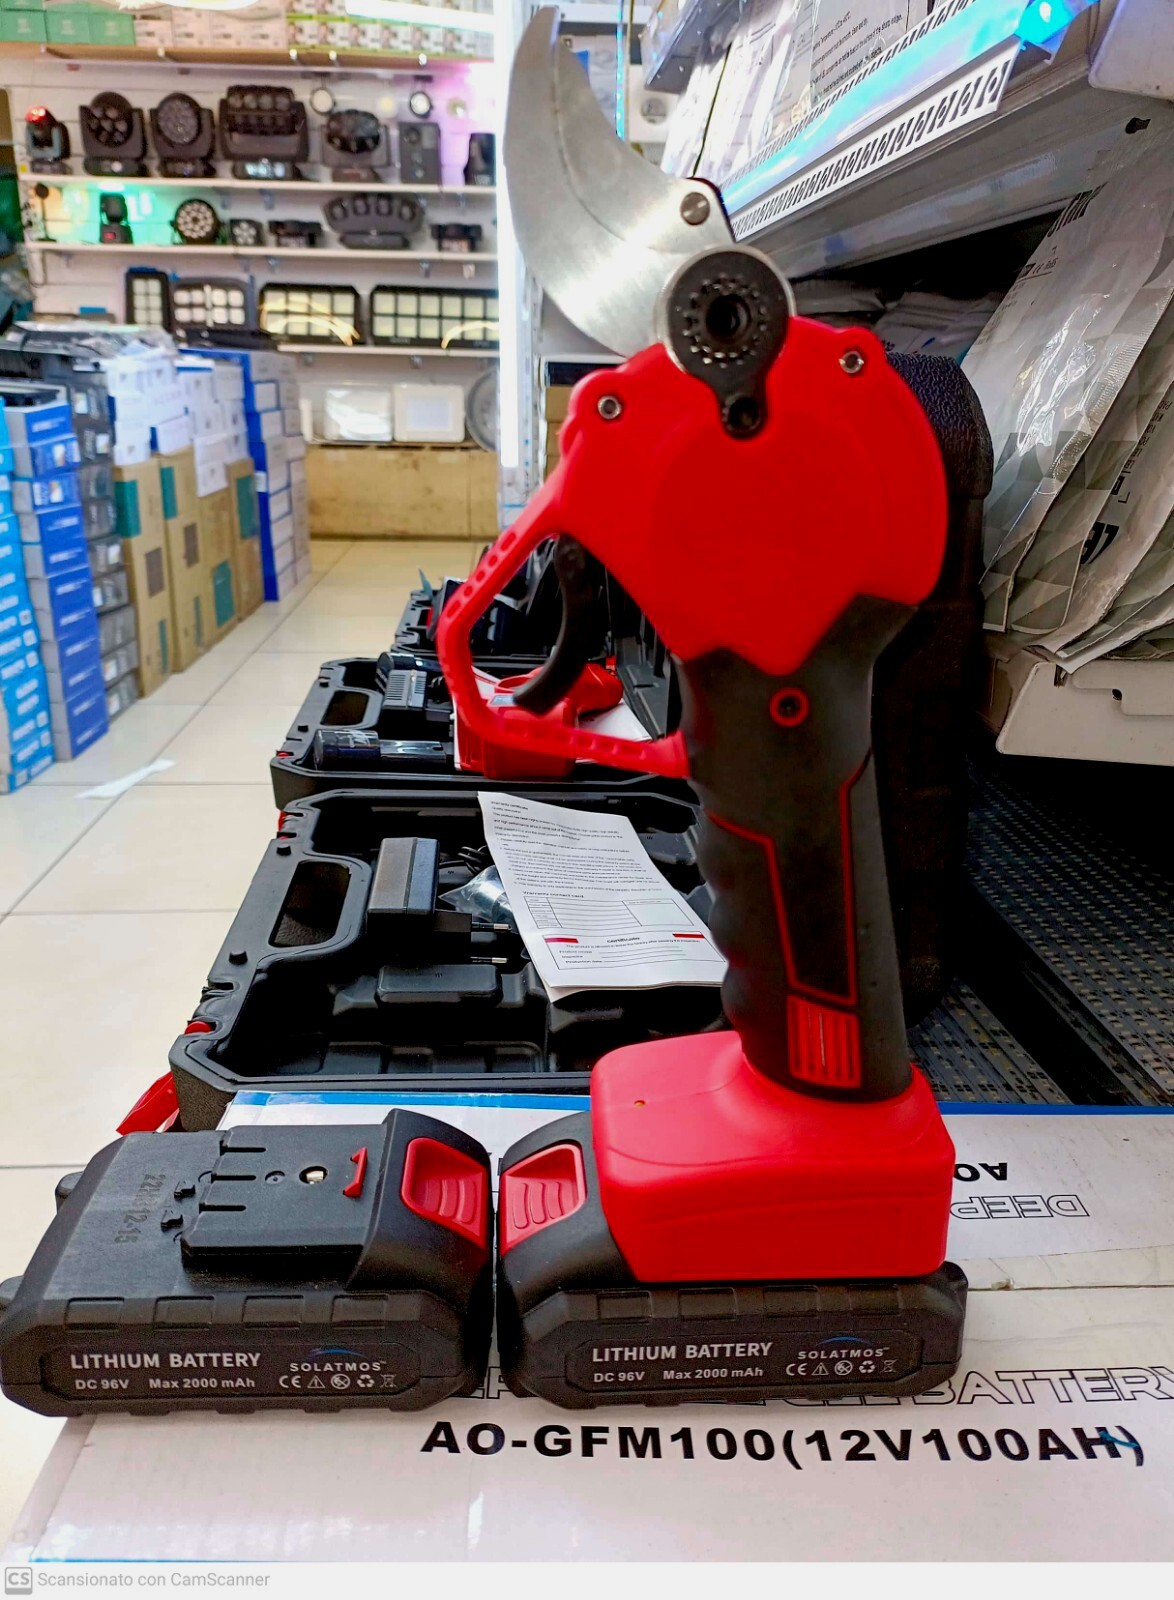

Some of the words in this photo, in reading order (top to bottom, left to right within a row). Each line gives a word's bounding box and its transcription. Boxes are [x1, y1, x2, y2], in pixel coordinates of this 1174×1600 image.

[949, 1194, 1091, 1220] DEEP
[70, 1352, 160, 1369] LITHIUM
[168, 1352, 261, 1368] BATTERY
[592, 1345, 677, 1362] LITHIUM
[684, 1342, 773, 1359] BATTERY
[75, 1379, 98, 1390] DC
[101, 1378, 130, 1390] 96V
[149, 1377, 179, 1389] Max
[182, 1376, 218, 1389] 2000
[221, 1377, 256, 1388] mAh
[593, 1372, 615, 1383] DC
[618, 1371, 646, 1382] 96V
[663, 1370, 692, 1380] Max
[694, 1368, 728, 1379] 2000
[731, 1367, 764, 1378] mAh
[420, 1421, 1145, 1470] AO-GFM100(12V100AH)
